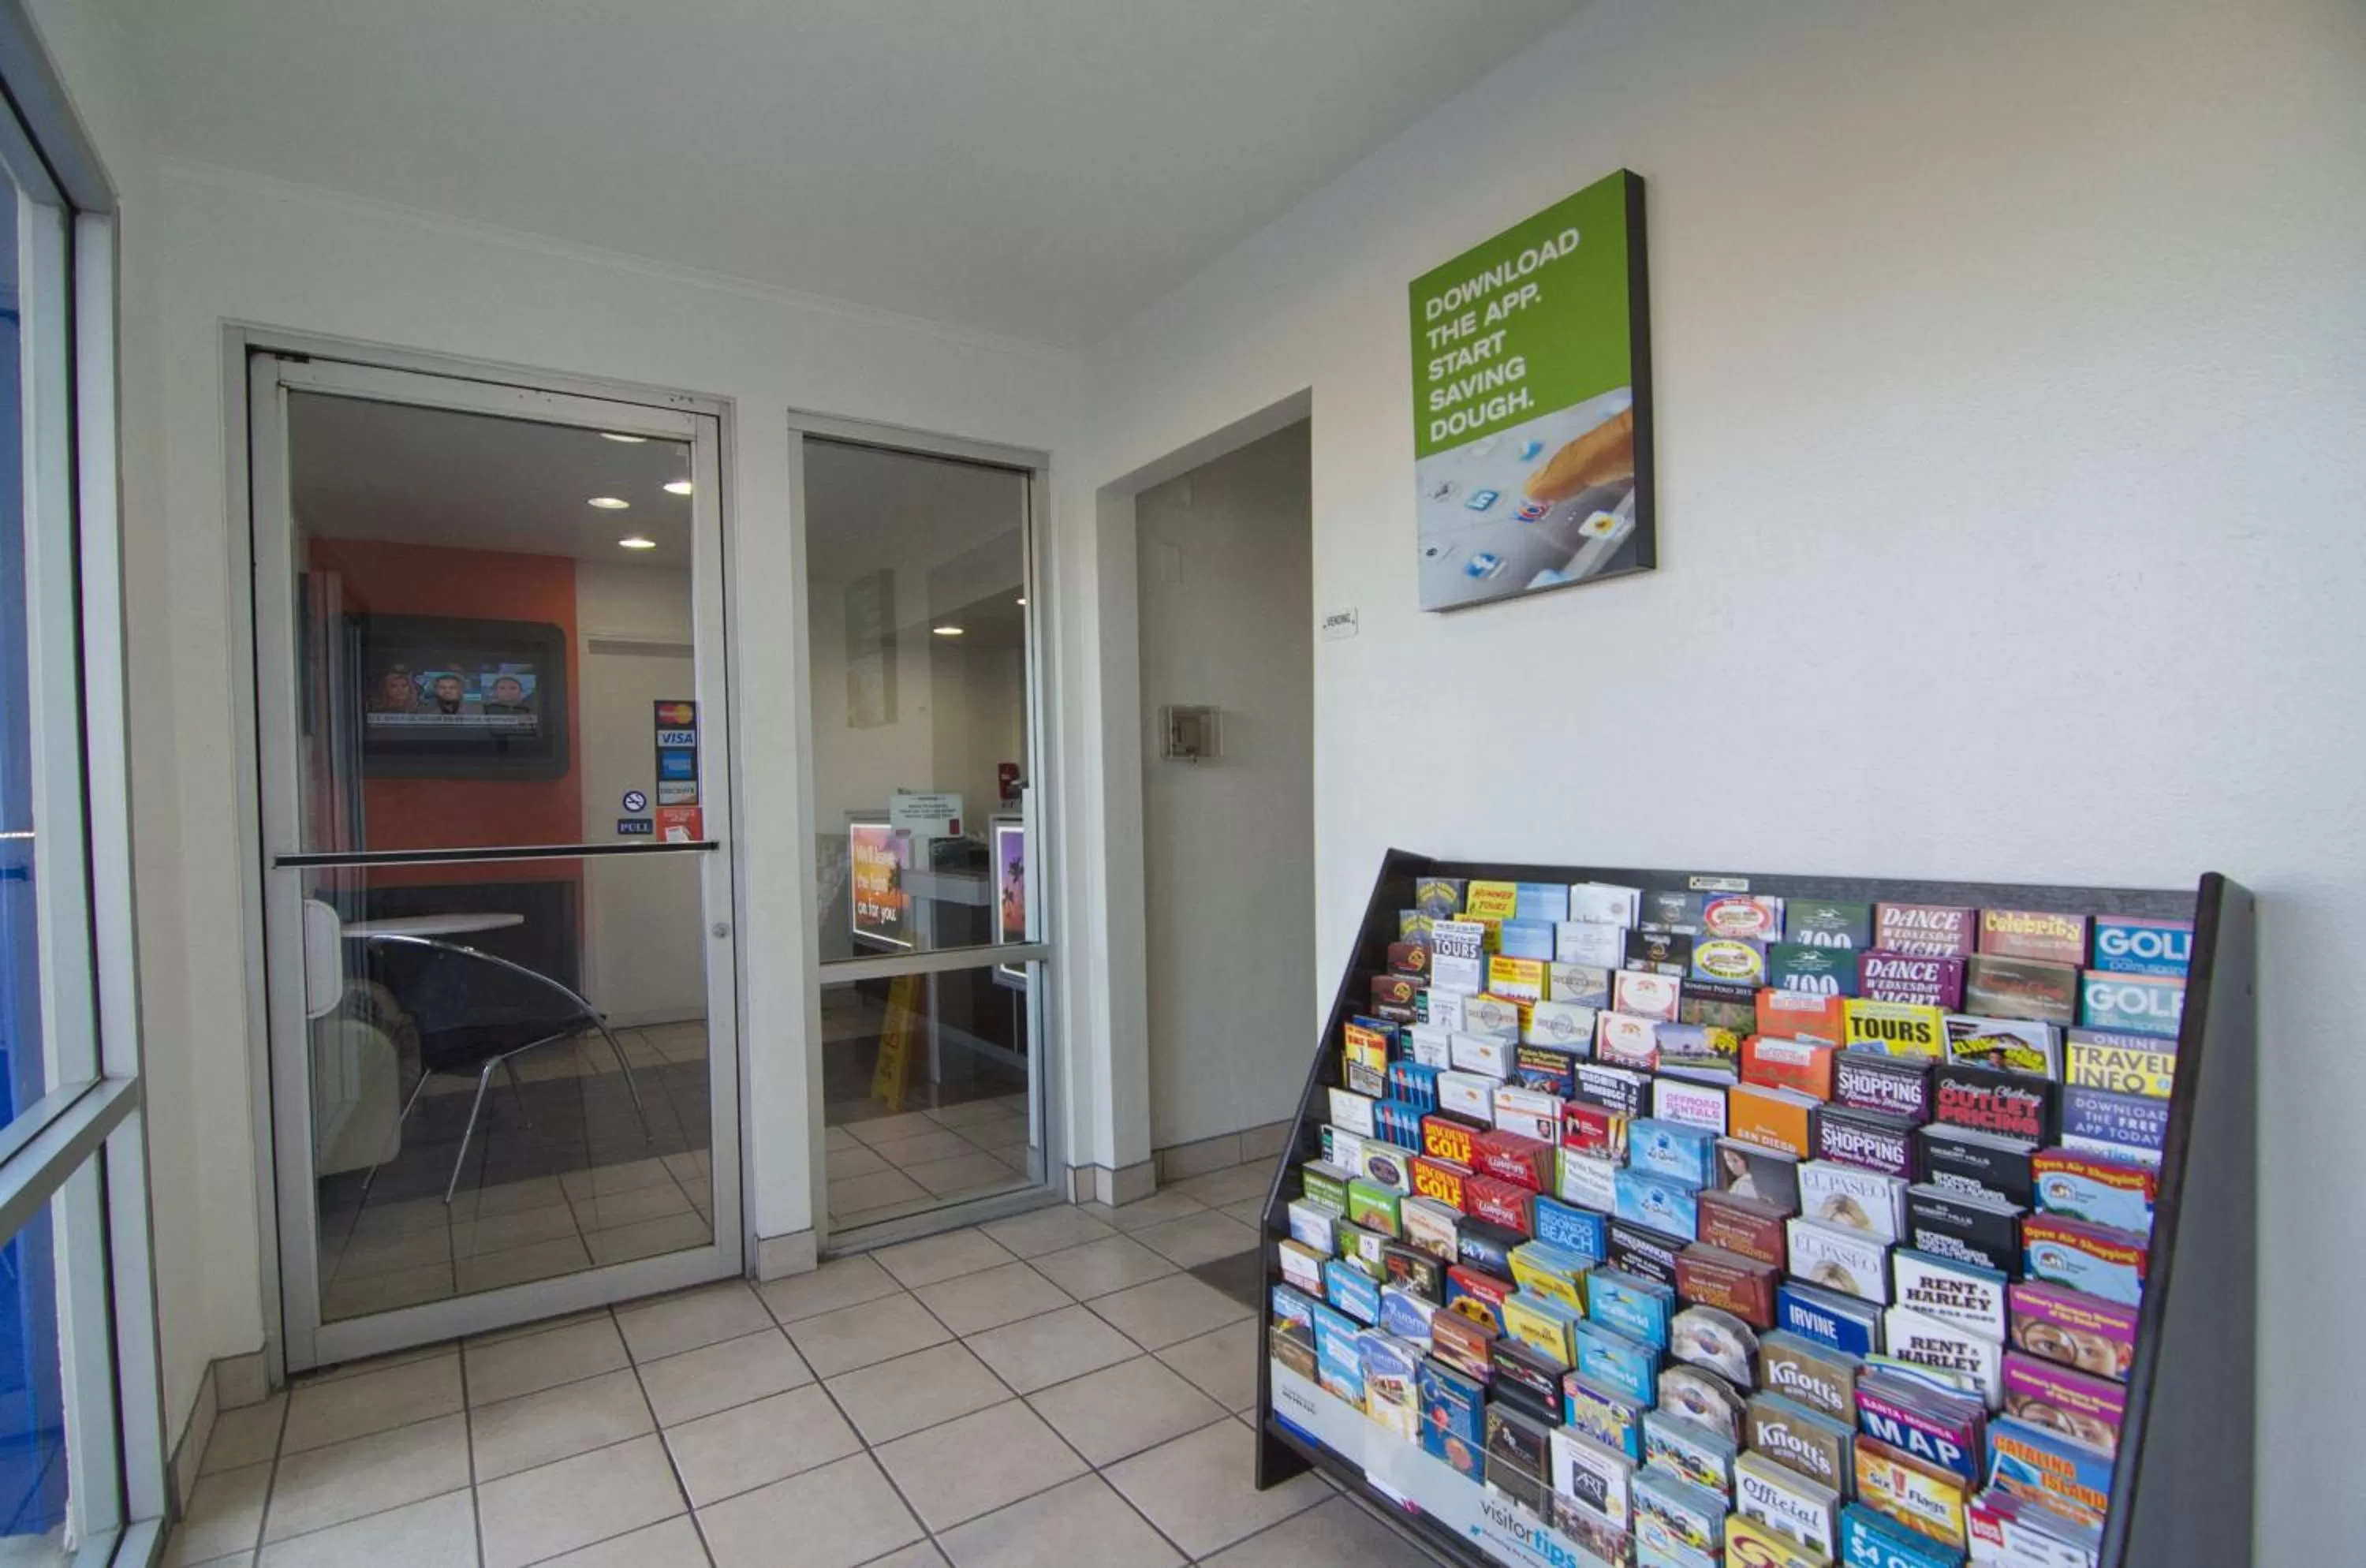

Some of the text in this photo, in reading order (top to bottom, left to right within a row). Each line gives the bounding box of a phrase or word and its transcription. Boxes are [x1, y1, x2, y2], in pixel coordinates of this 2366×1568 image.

[1425, 227, 1580, 322] DOWNLOAD
[1426, 282, 1542, 350] THE APP.
[1427, 330, 1507, 382] START
[1429, 356, 1526, 412] SAVING
[1431, 387, 1535, 442] DOUGH.
[662, 733, 693, 744] VISA
[621, 823, 651, 832] PULL
[1883, 908, 1963, 931] DANCE
[1434, 939, 1477, 958] TOURS
[1883, 927, 1962, 943] WEDNESDAY
[1886, 939, 1960, 958] NIGHT
[1865, 959, 1941, 982] DANCE
[1867, 979, 1942, 993] WEDNESDAY
[1849, 1017, 1931, 1043] TOURS
[2094, 1034, 2158, 1051] ONLINE
[2071, 1045, 2175, 1075] TRAVEL
[1838, 1072, 1922, 1104] SHOPPING
[2075, 1065, 2145, 1093] INFO
[1939, 1088, 2036, 1118] OUTLET
[2075, 1097, 2168, 1122] DOWNLOAD
[1939, 1106, 2040, 1136] PRICING
[2075, 1122, 2161, 1147] APP TODAY
[2085, 1111, 2158, 1133] THE FREE
[1426, 1136, 1472, 1164] GOLF
[1822, 1128, 1905, 1165] SHOPPING
[1416, 1174, 1461, 1208] GOLF
[1541, 1223, 1594, 1253] BEACH
[1905, 1287, 1991, 1312] HARLEY
[1920, 1276, 1977, 1295] RENT
[1789, 1304, 1838, 1340] IRVINE
[1897, 1348, 1982, 1372] HARLEY
[1910, 1336, 1968, 1356] RENT
[1767, 1359, 1843, 1410] Knott's
[1861, 1398, 1954, 1441] SANTA MONICA
[1756, 1421, 1832, 1476] Knott's
[1867, 1410, 1961, 1465] MAP
[1994, 1434, 2077, 1480] CATALINA
[1577, 1472, 1604, 1502] ART
[1870, 1472, 1946, 1514] Six Flags
[2040, 1469, 2108, 1511] ISLAND
[1743, 1477, 1819, 1528] Official
[1480, 1499, 1577, 1568] visitortips
